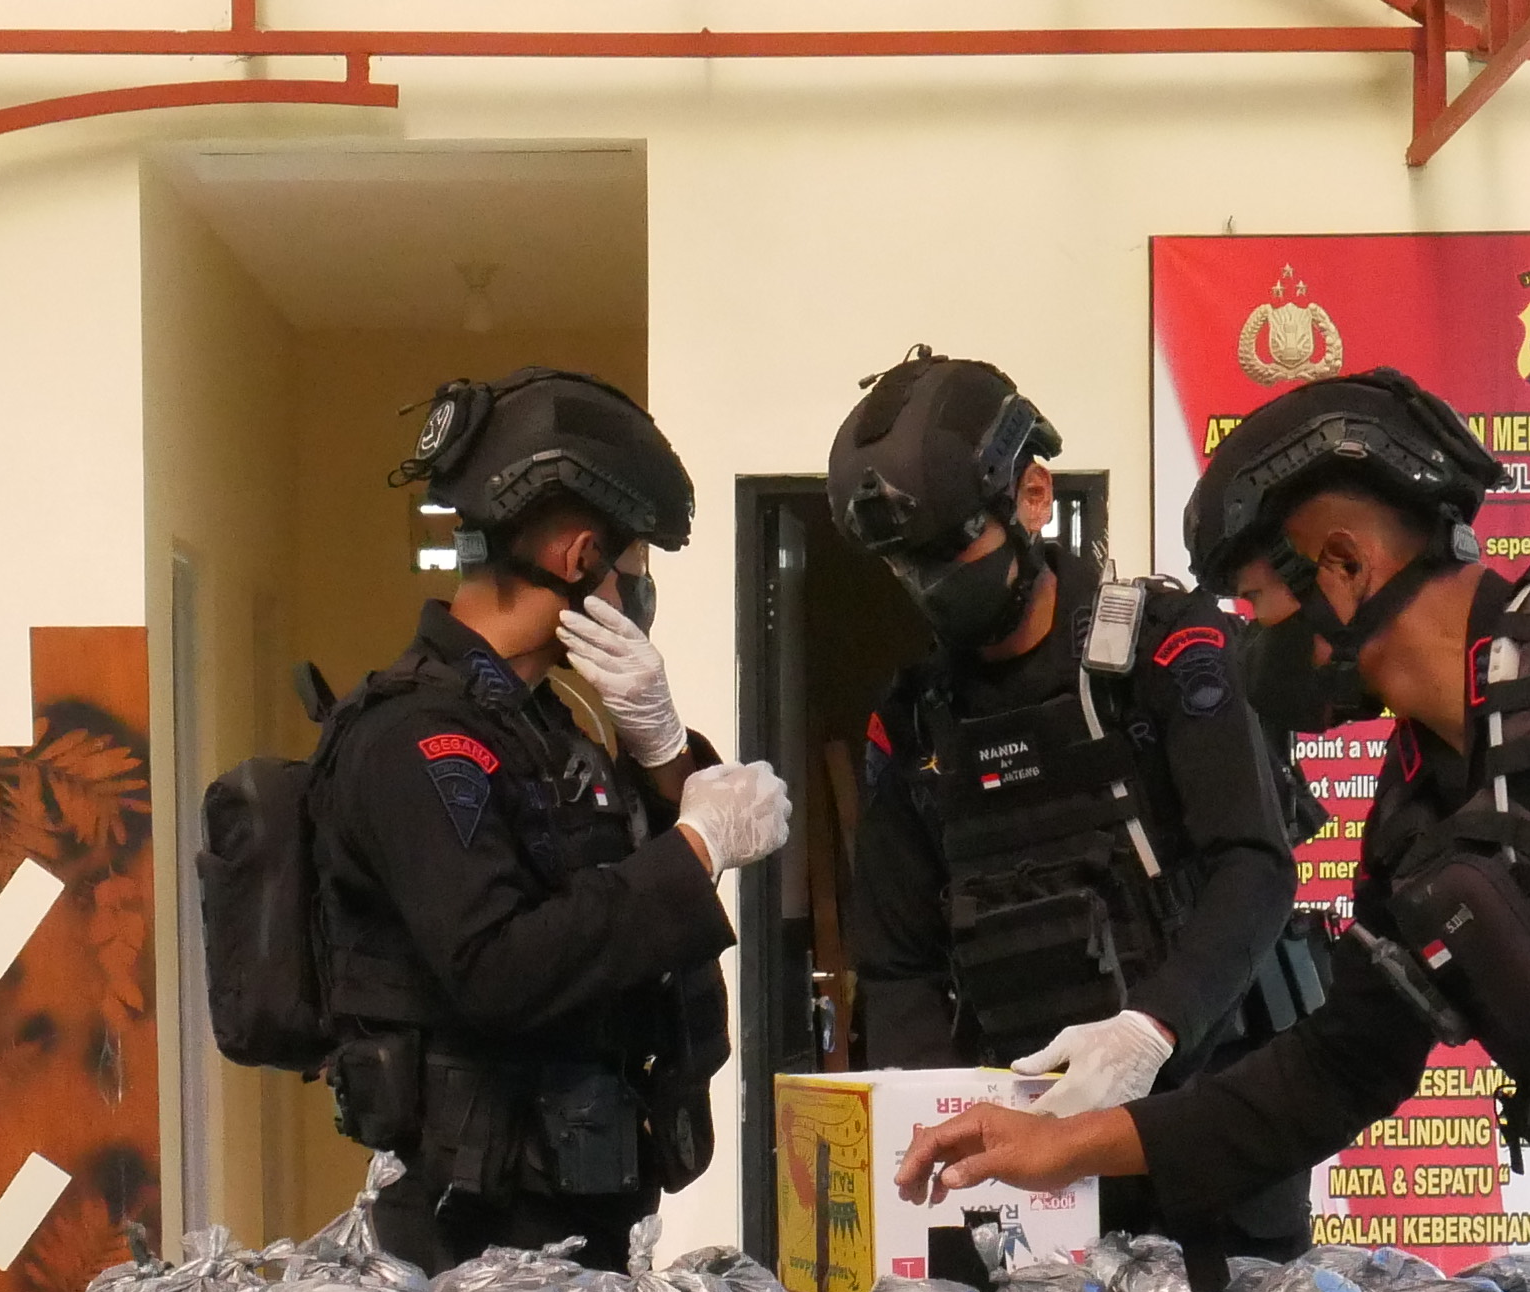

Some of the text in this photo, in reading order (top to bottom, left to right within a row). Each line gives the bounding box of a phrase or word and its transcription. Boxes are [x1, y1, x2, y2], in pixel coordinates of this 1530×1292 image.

[1204, 418, 1242, 454] AT
[429, 739, 490, 765] GEGANA
[979, 741, 1029, 761] NANDA
[1296, 736, 1387, 759] point a w
[1334, 775, 1378, 799] willi
[1305, 816, 1339, 844] ari
[1414, 1067, 1516, 1097] ESELAM
[1371, 1118, 1490, 1146] PELINDUNG
[827, 1170, 855, 1194] RAJ
[1330, 1167, 1386, 1196] MATA
[1392, 1167, 1408, 1196] &
[1414, 1166, 1493, 1195] SEPATU
[1311, 1214, 1396, 1245] AGALAH
